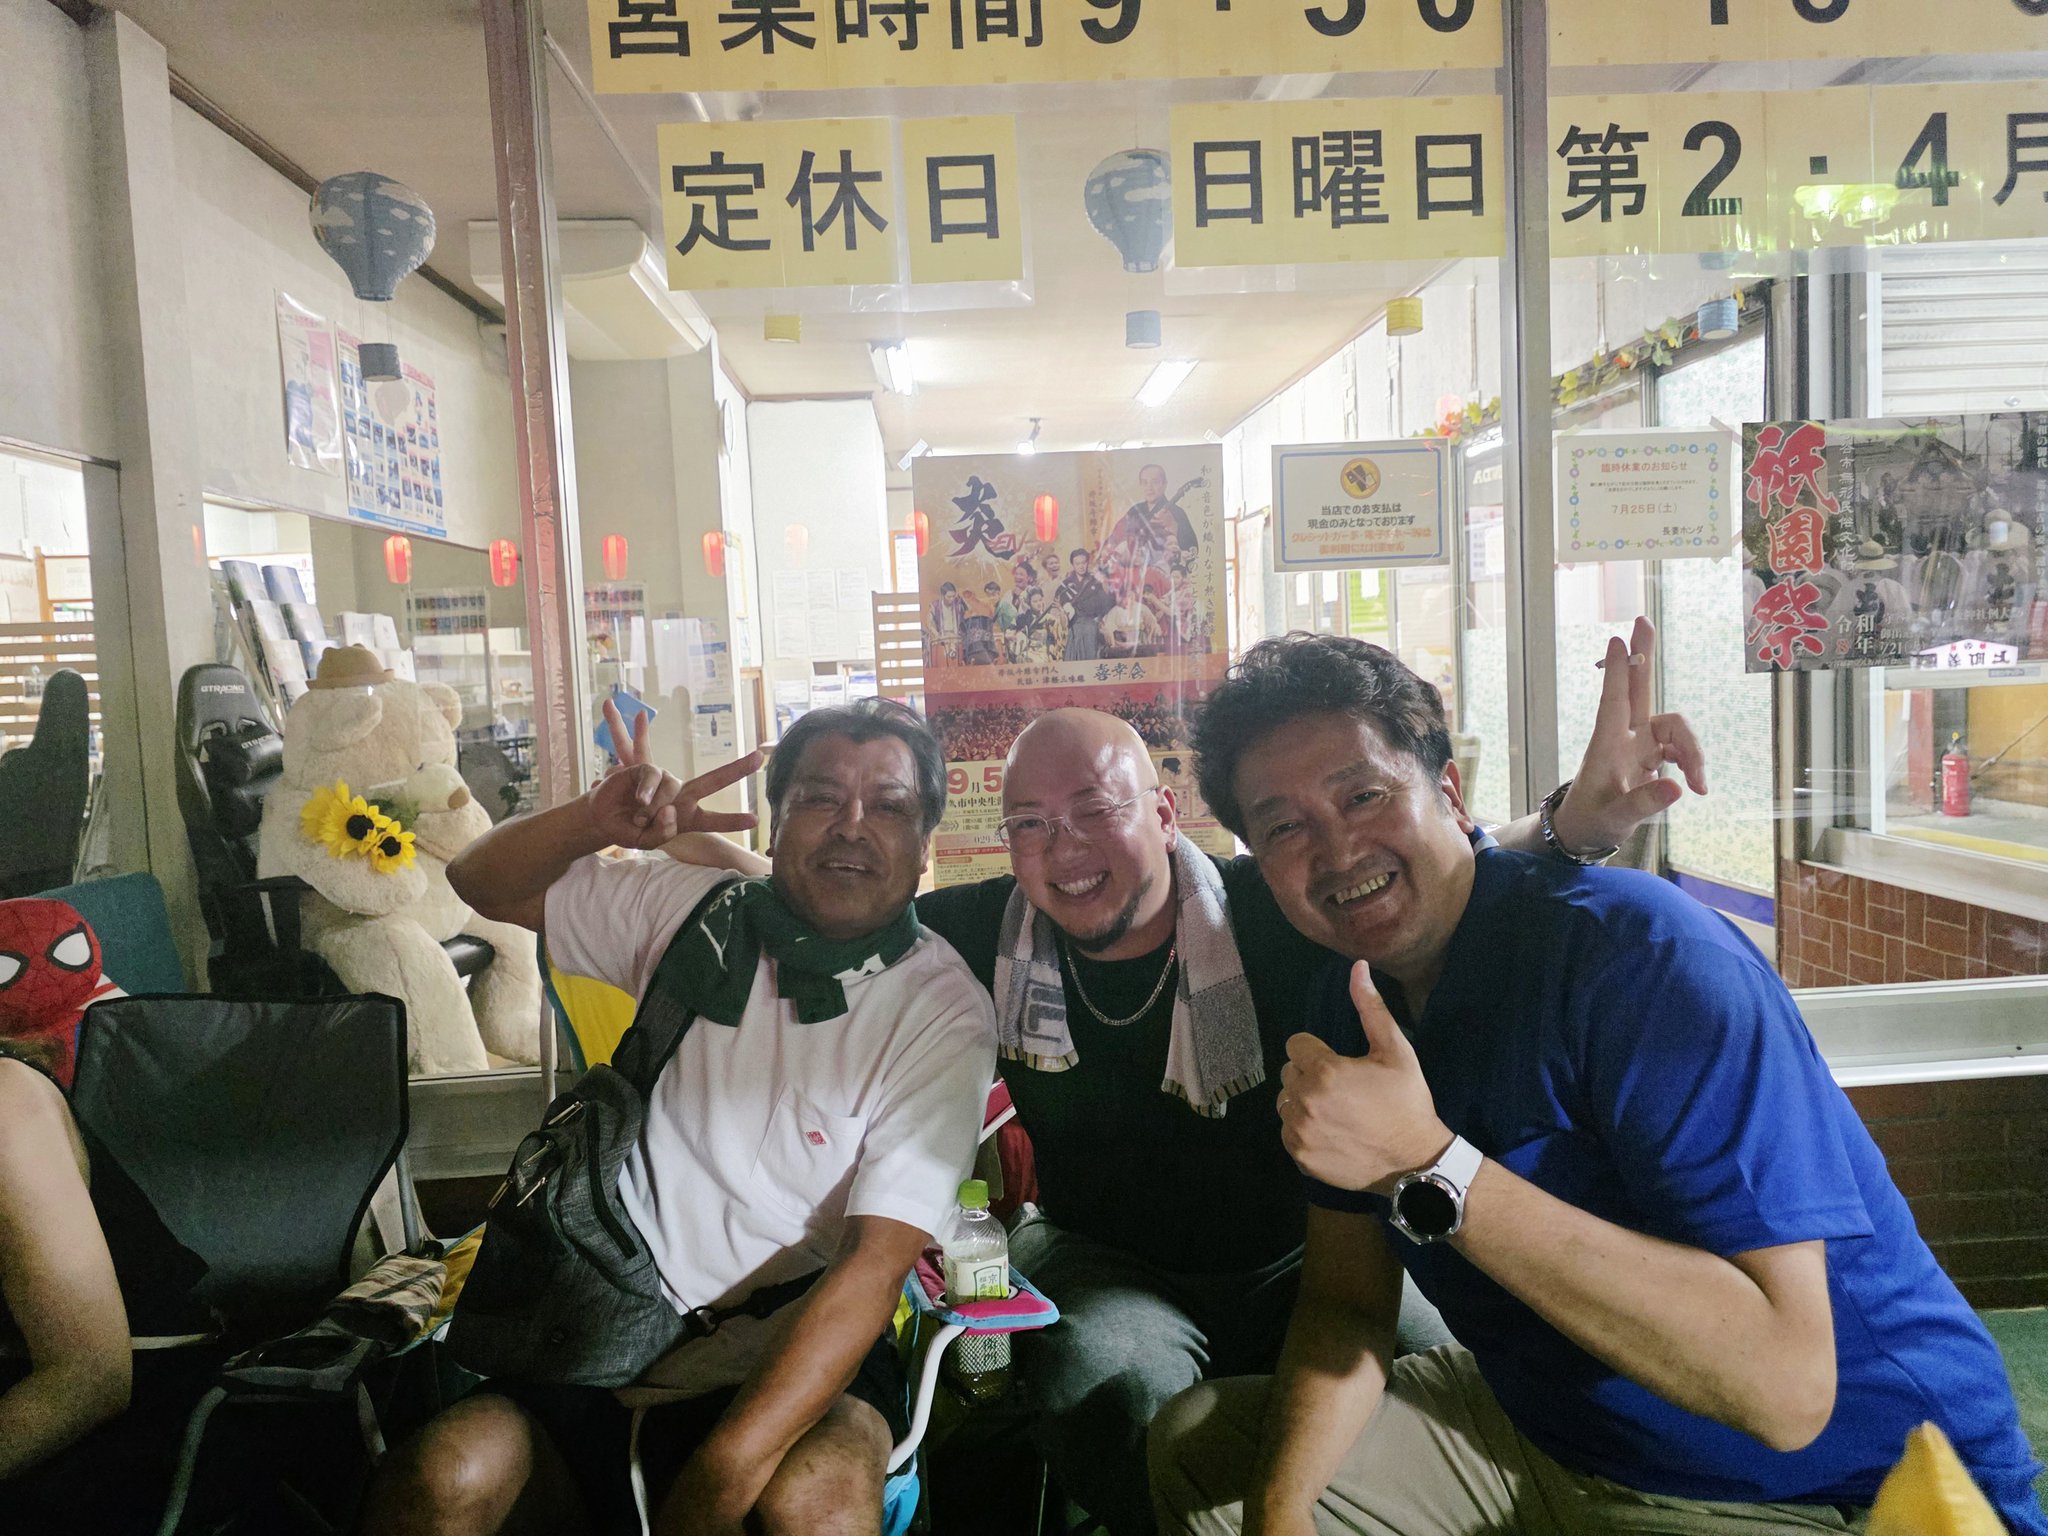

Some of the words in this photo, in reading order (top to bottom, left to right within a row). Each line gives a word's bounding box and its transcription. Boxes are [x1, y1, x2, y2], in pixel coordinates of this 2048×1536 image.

[672, 150, 1001, 256] 定休日
[1193, 129, 1487, 229] 日曜日
[1600, 461, 1688, 473] 臨時休業のお知らせ
[1321, 503, 1402, 516] 当店でのお支払は
[947, 475, 1006, 561] 炎
[1307, 515, 1416, 530] 現金のみとなっております
